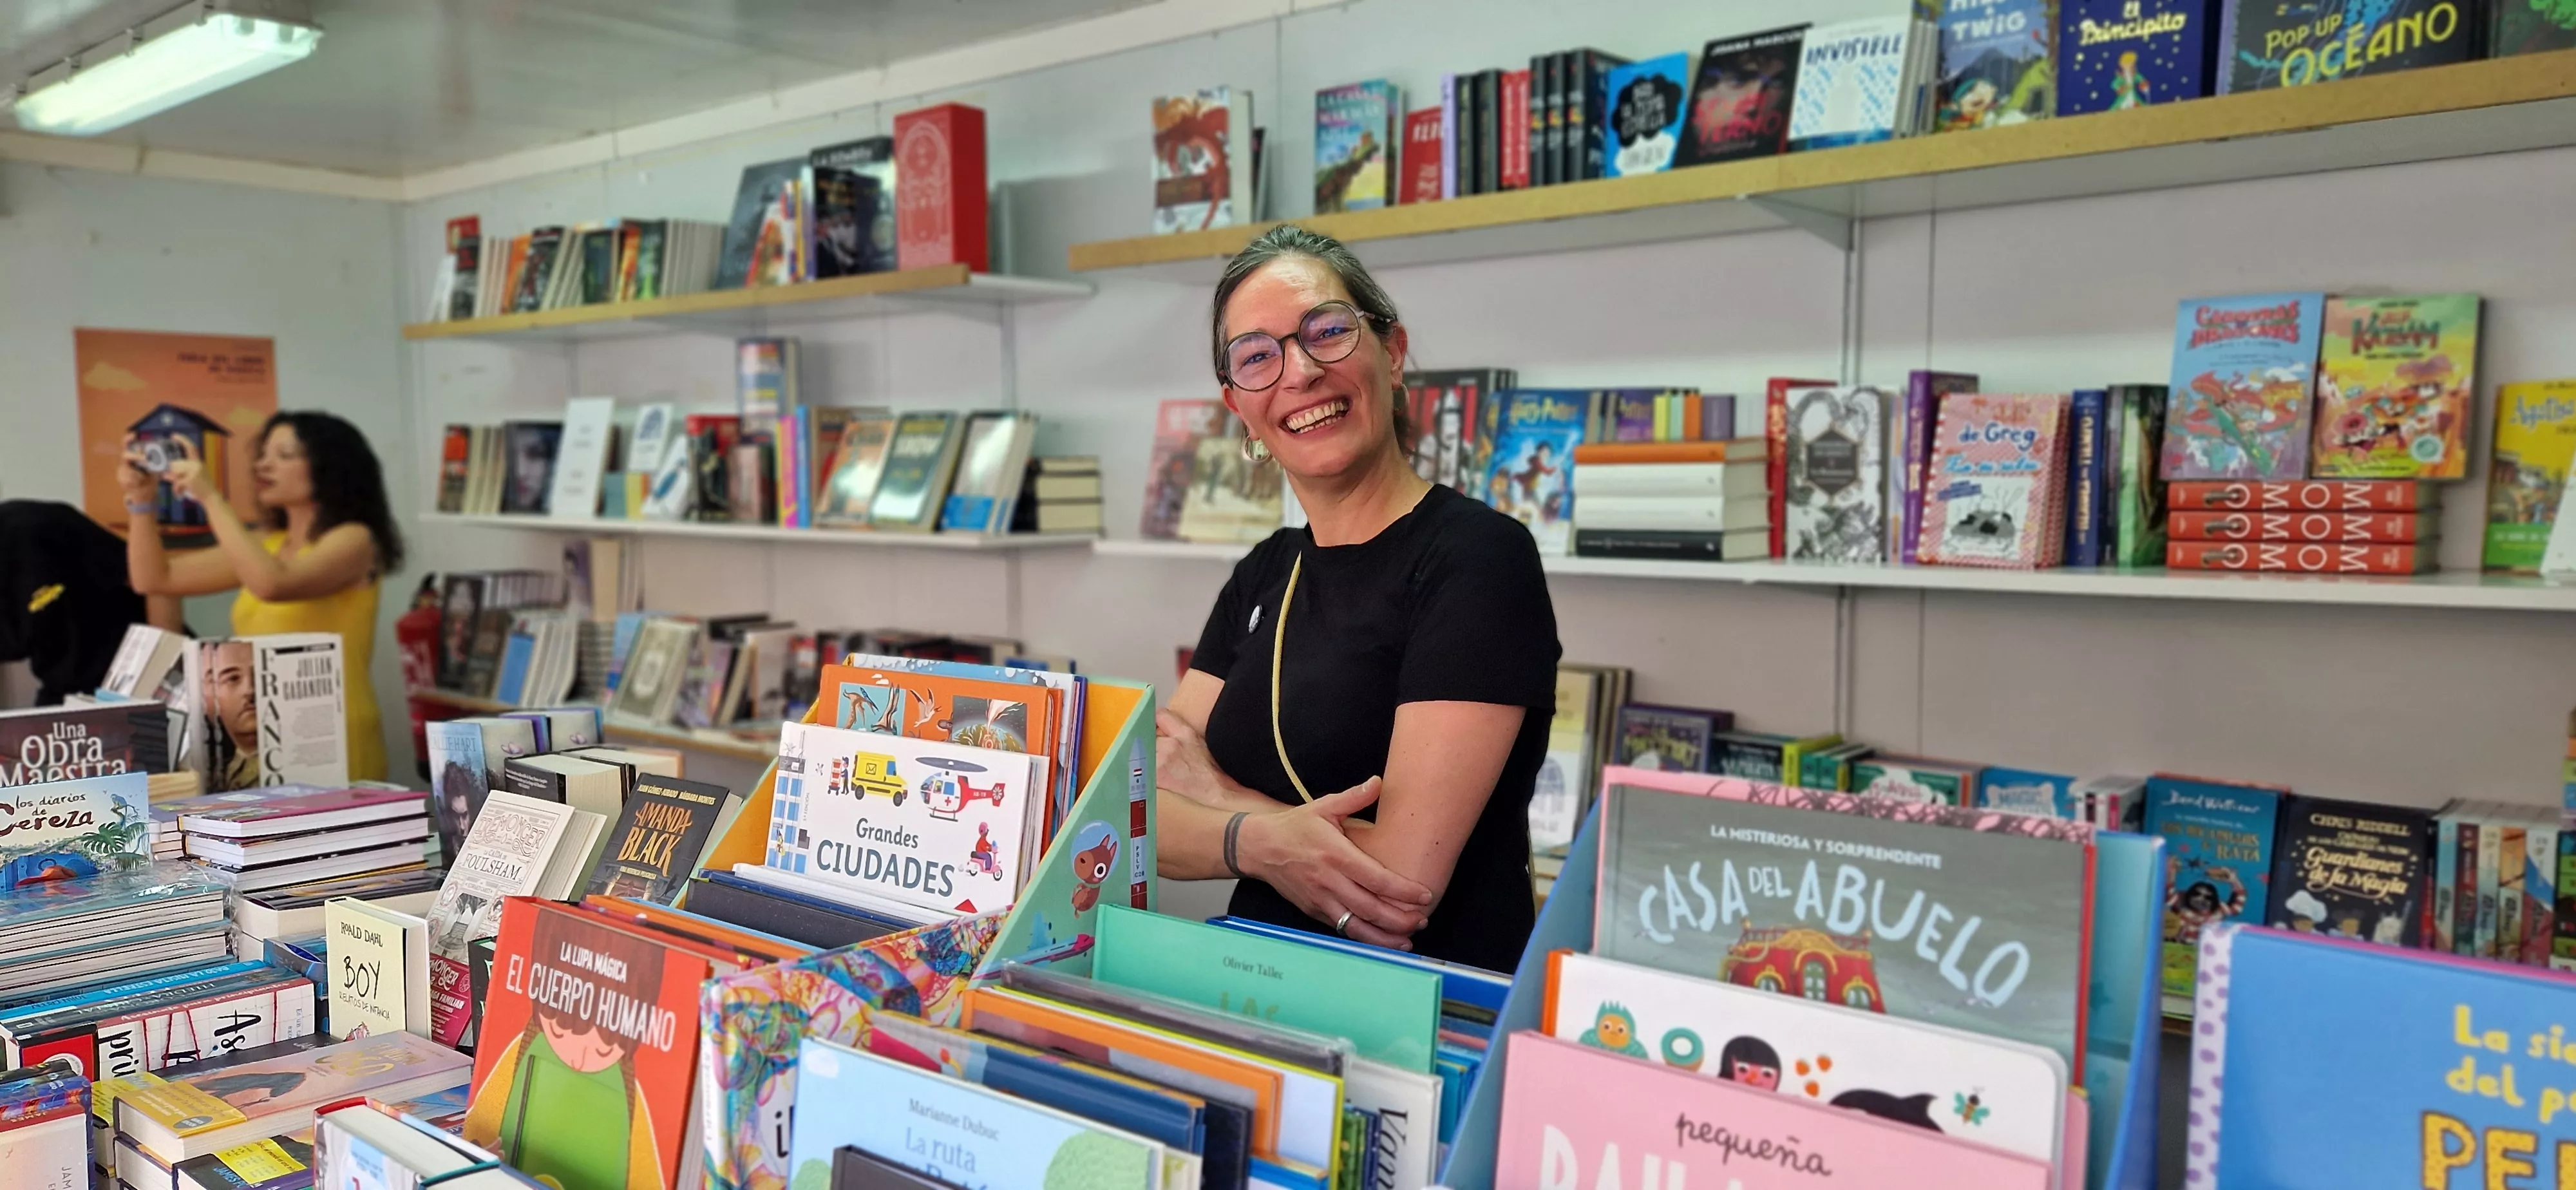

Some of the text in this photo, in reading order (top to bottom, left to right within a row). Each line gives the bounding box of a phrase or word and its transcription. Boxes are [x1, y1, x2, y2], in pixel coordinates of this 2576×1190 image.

[1951, 11, 2027, 41] TWIG
[2079, 13, 2186, 45] Principito
[2265, 14, 2342, 59] POP UP
[2280, 2, 2458, 88] OCÉANO
[1984, 422, 2037, 451] Greg
[53, 721, 87, 740] Una
[21, 733, 104, 770] Obra
[16, 793, 87, 809] los diarios
[32, 807, 47, 817] de
[634, 801, 693, 835] AMANDA
[0, 802, 95, 837] Cereza
[856, 817, 920, 849] Grandes
[616, 826, 683, 877] BLACK
[1710, 823, 1942, 871] LA MISTERIOSA Y SORPRENDENTE
[2304, 846, 2404, 874] Guardianes
[462, 853, 522, 882] FOULSHAM
[816, 840, 956, 898] CIUDADES
[2351, 871, 2409, 899] Magia
[341, 921, 384, 948] ROALD DAHL
[1638, 858, 2031, 1008] CASA DEL ABUELO
[343, 956, 381, 1000] BOY
[560, 941, 628, 984] LA LUPA MÁGICA
[1222, 956, 1284, 981] Olivier Tallec
[339, 990, 391, 1021] RELATOS DE INFANCIA
[506, 954, 677, 1053] EL CUERPO HUMANO
[2454, 1005, 2510, 1054] La
[2445, 1055, 2524, 1107] del
[909, 1097, 1000, 1142] Marianne Dubuc
[905, 1126, 976, 1174] La ruta
[1676, 1111, 1832, 1177] pequeña
